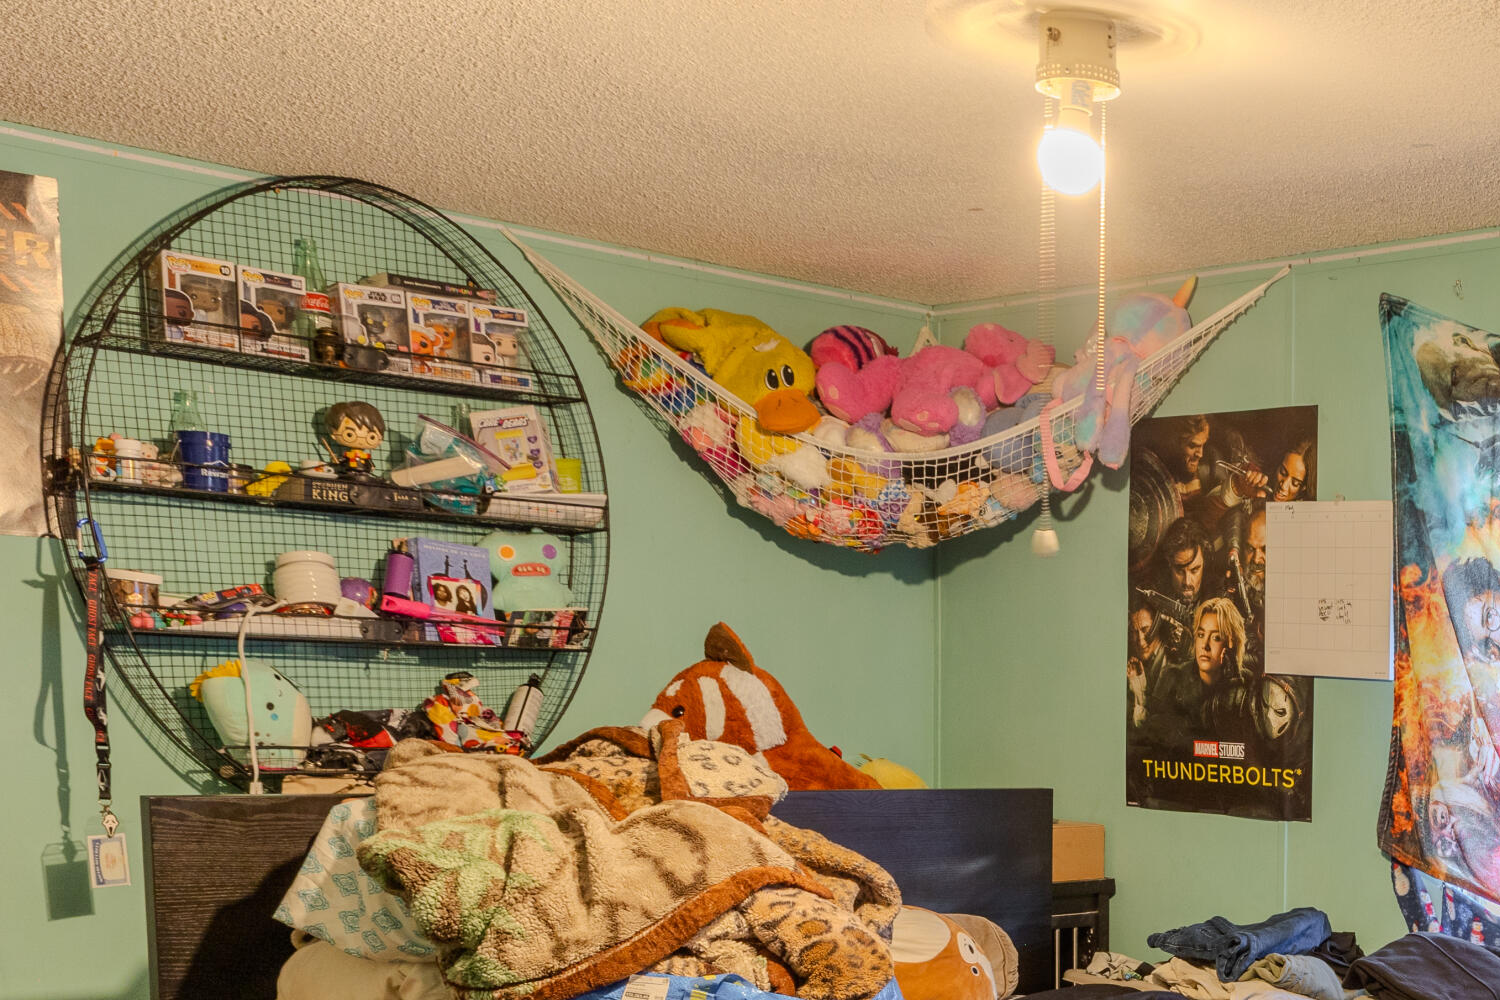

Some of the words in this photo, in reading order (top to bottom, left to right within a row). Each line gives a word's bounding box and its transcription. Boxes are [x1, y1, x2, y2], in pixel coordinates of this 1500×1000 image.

[312, 489, 349, 502] KING
[87, 599, 98, 627] GHOST
[87, 628, 97, 647] FACE
[86, 654, 96, 681] GHOST
[1194, 742, 1219, 757] MARVEL
[1219, 744, 1245, 758] STUDIOS
